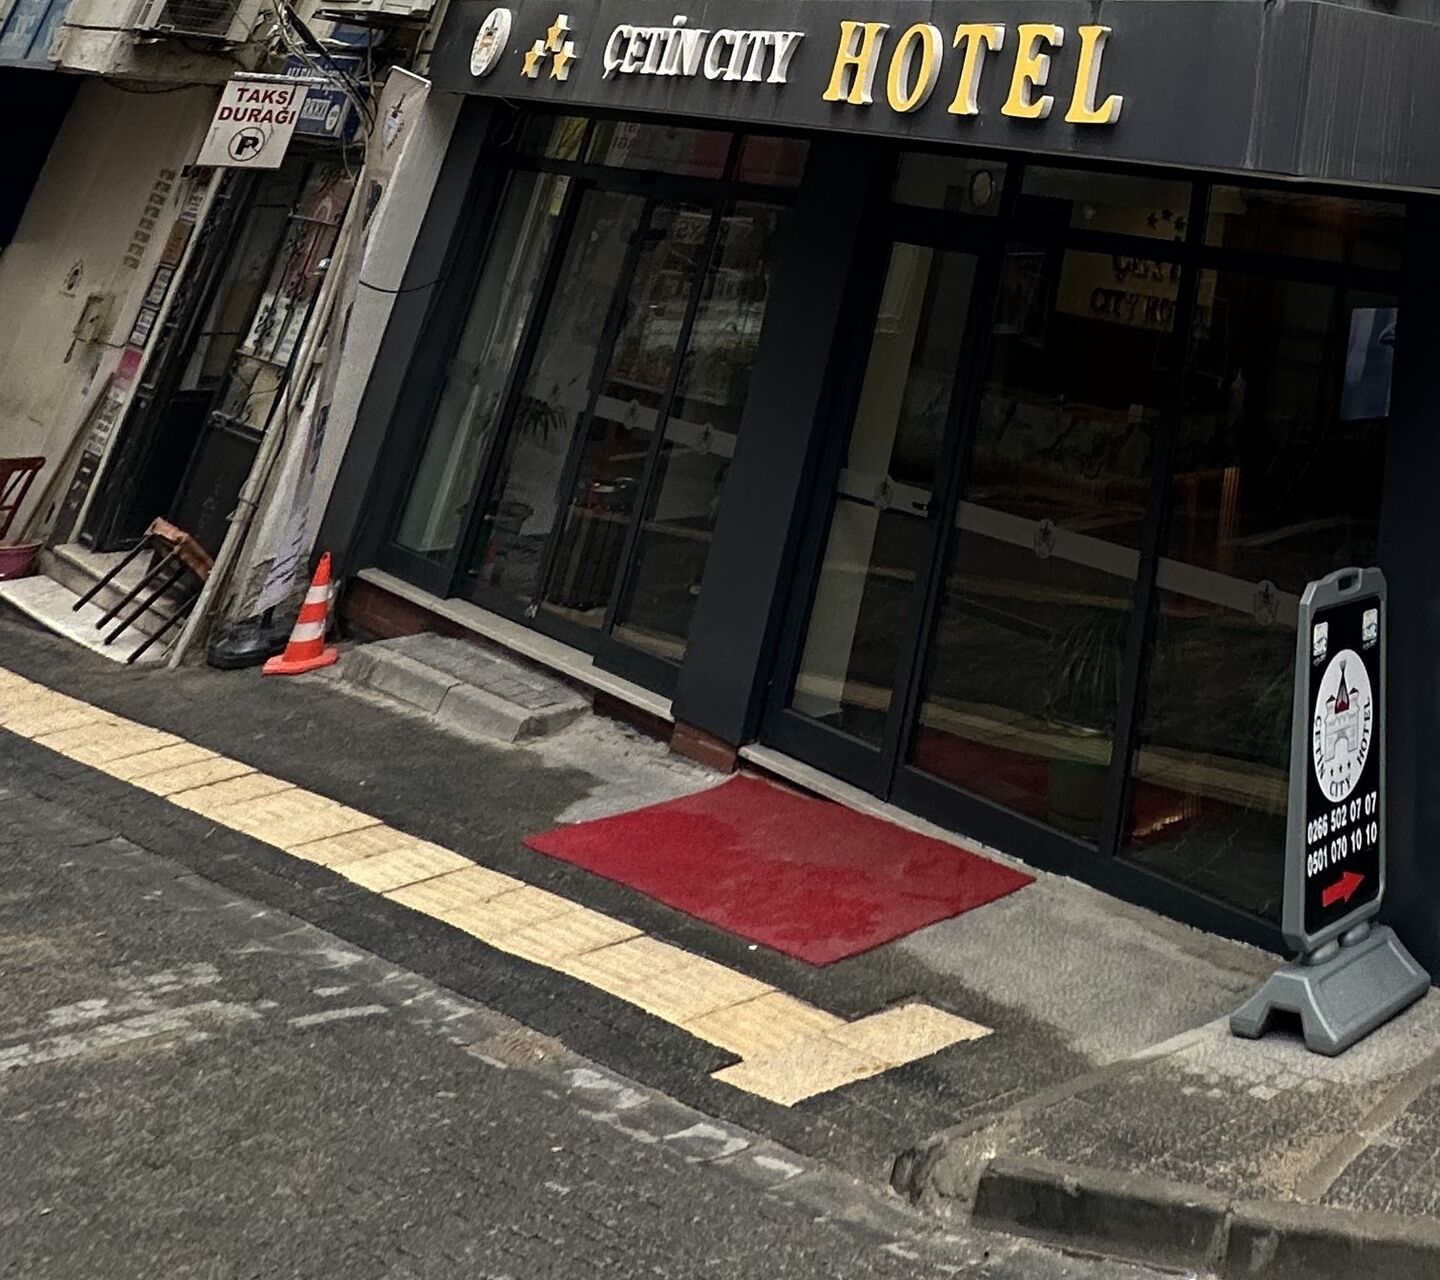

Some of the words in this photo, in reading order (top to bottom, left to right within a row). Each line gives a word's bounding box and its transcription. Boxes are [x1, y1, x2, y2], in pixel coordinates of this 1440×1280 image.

[602, 15, 710, 79] ÇETİN
[704, 29, 805, 83] CITY
[822, 19, 1124, 124] HOTEL
[218, 106, 297, 125] DURAĞI
[1307, 813, 1329, 845] 0266
[1331, 804, 1348, 832] 502
[1350, 797, 1362, 822] 07
[1364, 791, 1377, 815] 07
[1307, 847, 1329, 878] 0501
[1331, 834, 1348, 864] 070
[1351, 827, 1362, 853] 10
[1365, 821, 1378, 844] 10
